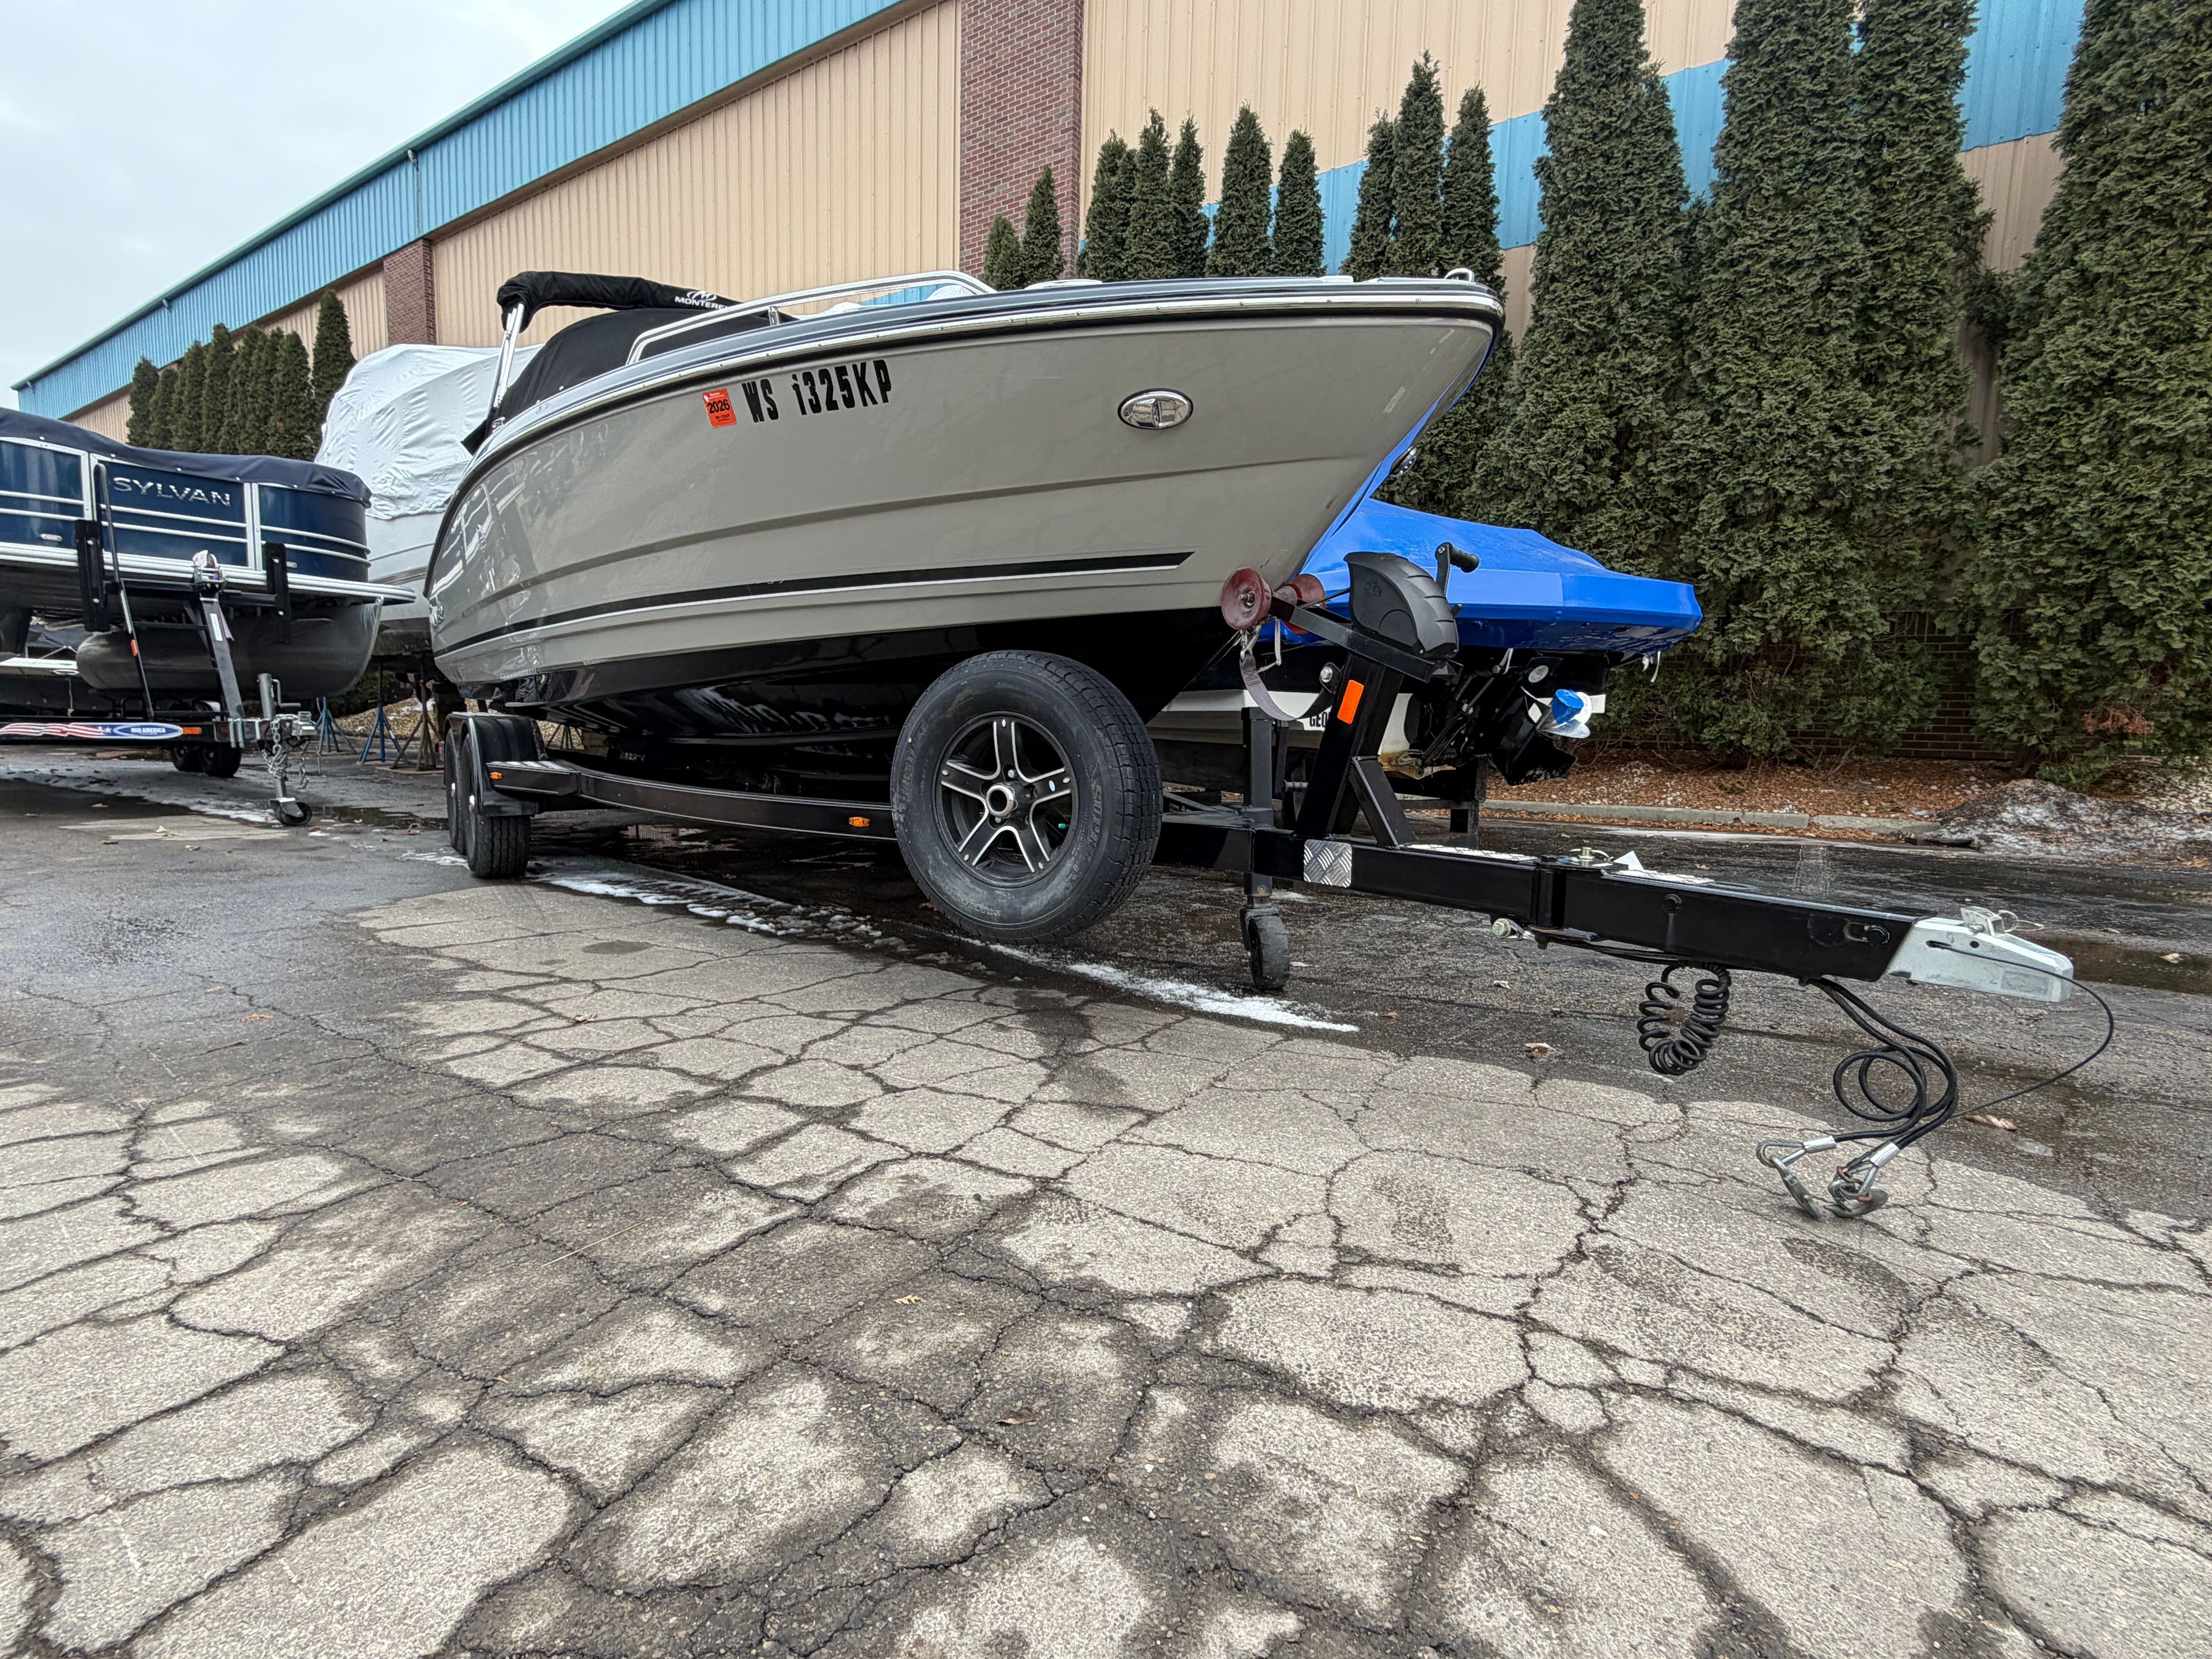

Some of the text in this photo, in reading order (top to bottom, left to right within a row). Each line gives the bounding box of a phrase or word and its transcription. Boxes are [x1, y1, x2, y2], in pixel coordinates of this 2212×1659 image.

[707, 399, 730, 414] 2026
[741, 378, 779, 423] WS
[113, 477, 230, 507] SYLVAN
